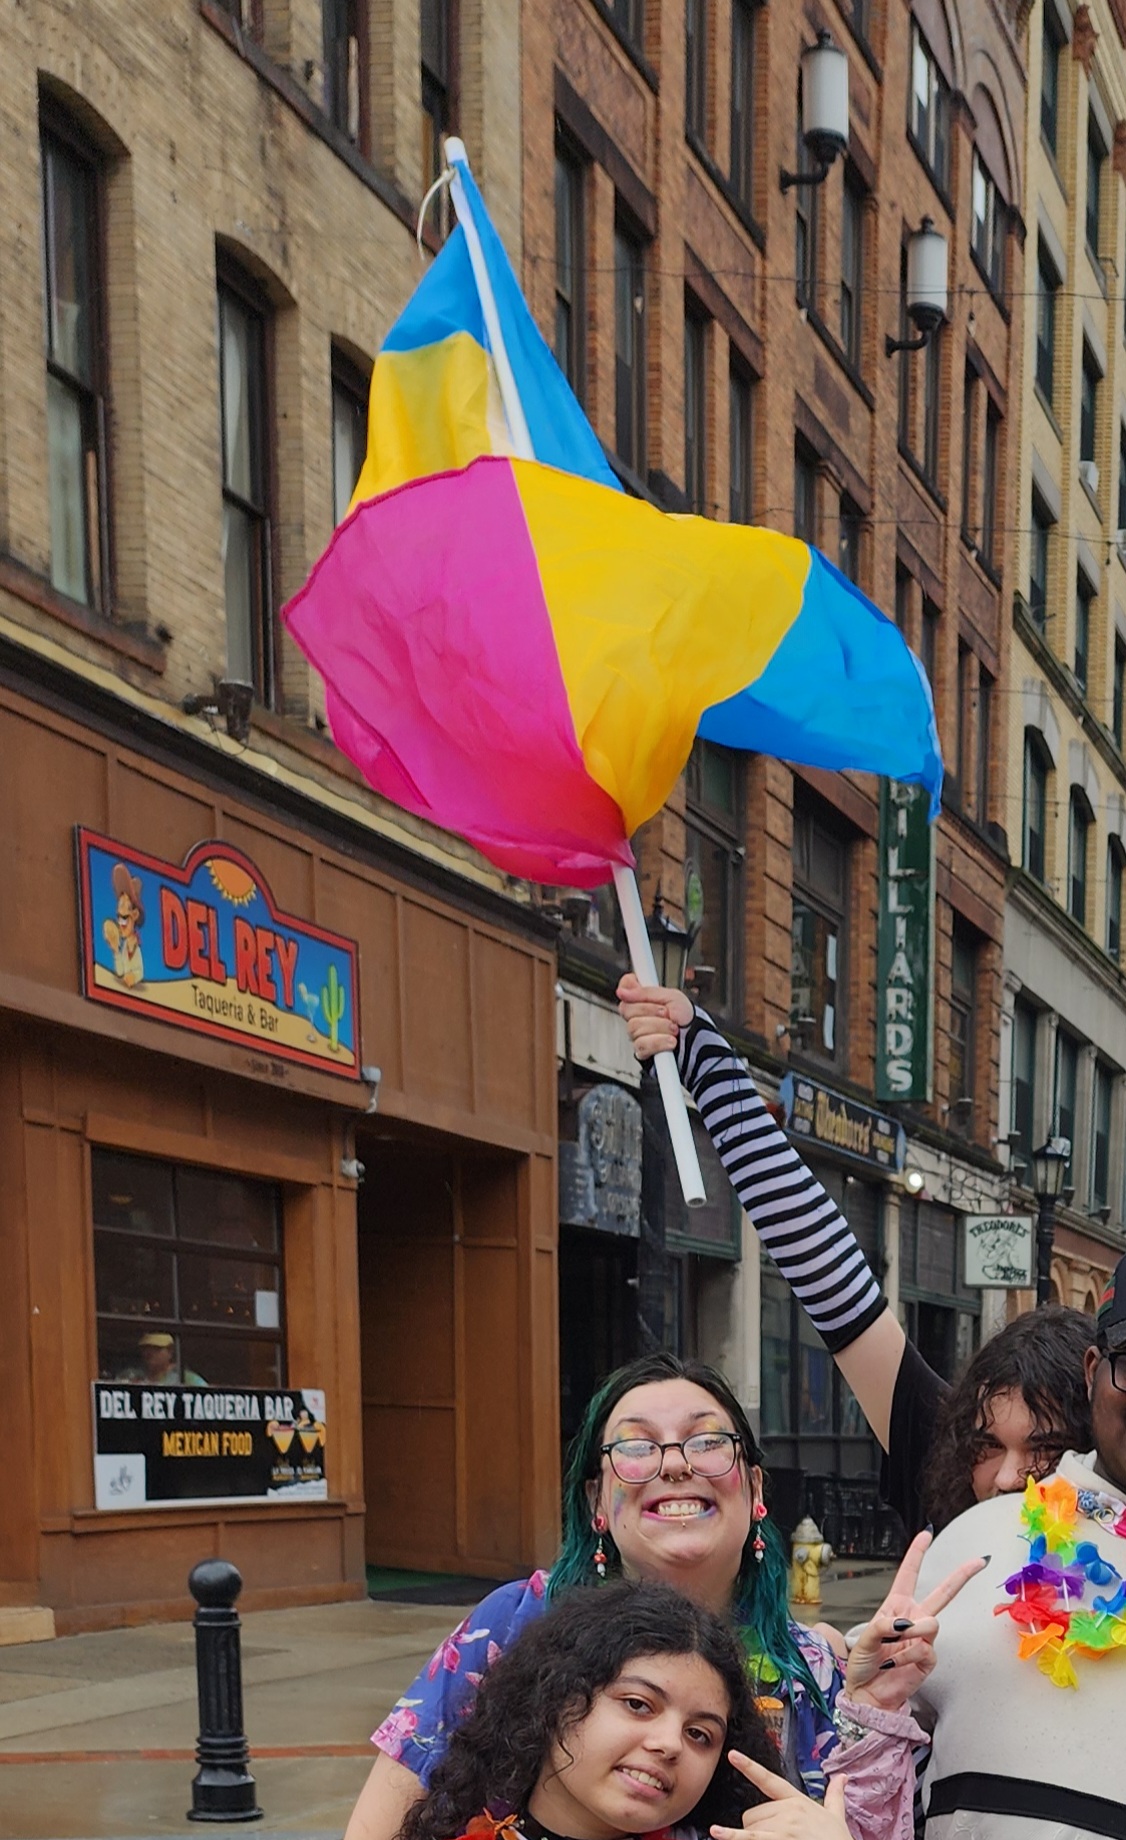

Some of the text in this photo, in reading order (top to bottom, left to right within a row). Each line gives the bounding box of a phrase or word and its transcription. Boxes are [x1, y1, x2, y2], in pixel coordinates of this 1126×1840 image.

[160, 887, 299, 1008] DEL REY
[191, 984, 279, 1032] Taqueria & Bar
[100, 1390, 295, 1421] DEL REY TAQUERIA BAR
[162, 1430, 253, 1457] MEXICAN FOOD
